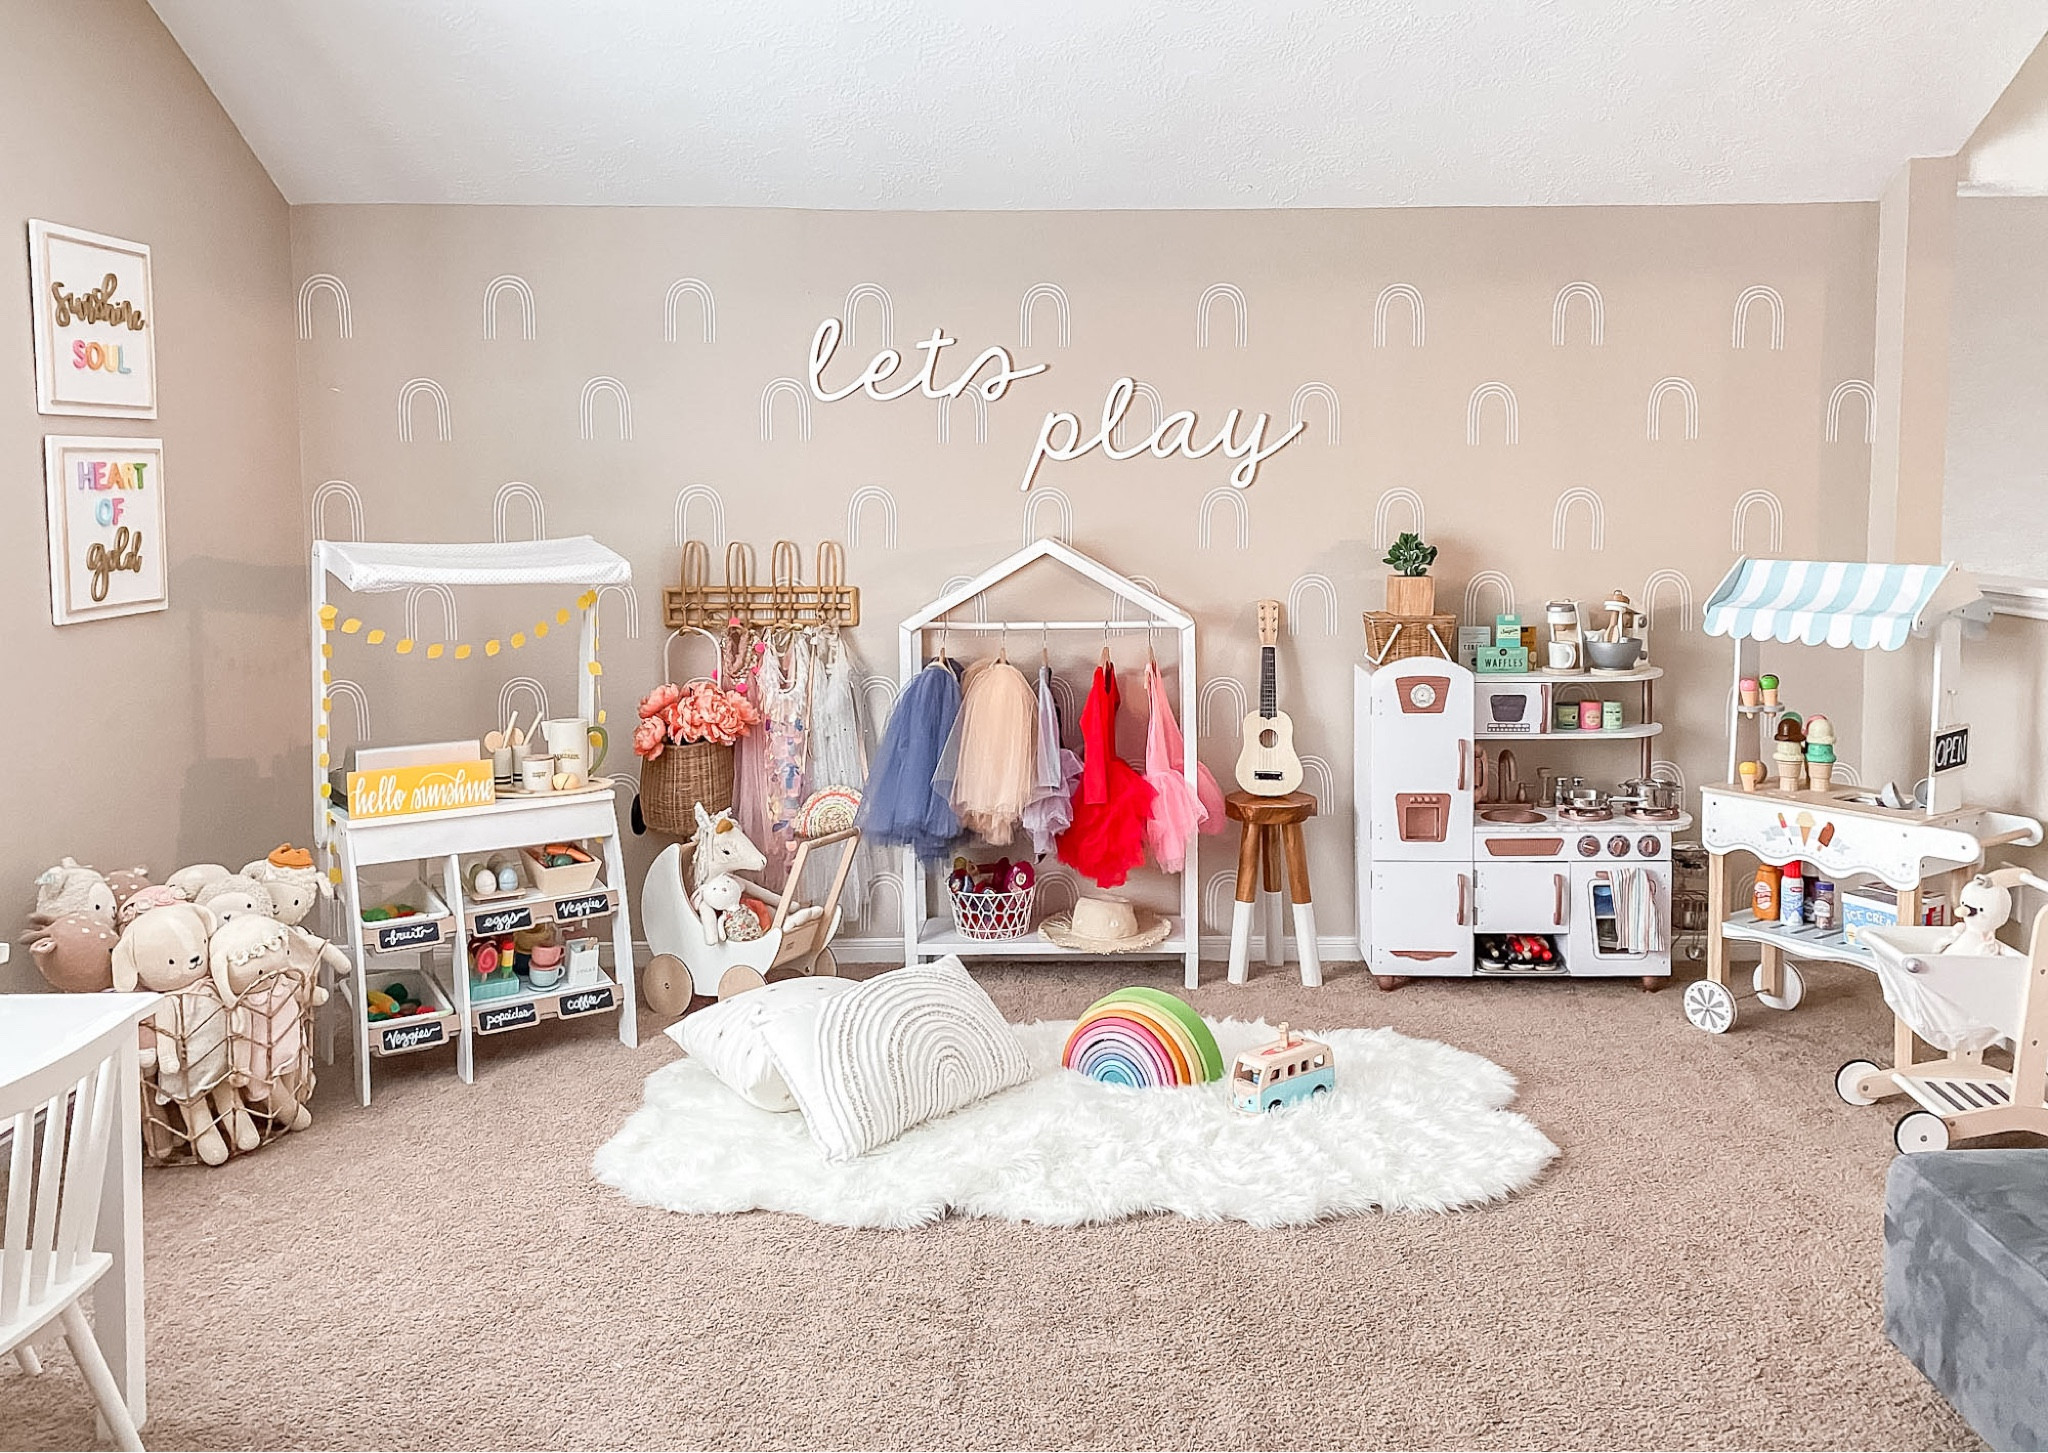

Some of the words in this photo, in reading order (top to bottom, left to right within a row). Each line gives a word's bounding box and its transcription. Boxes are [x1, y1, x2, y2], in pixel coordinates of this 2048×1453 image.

[72, 339, 132, 374] SOUL
[809, 318, 1047, 401] lets
[1020, 377, 1305, 492] play
[77, 461, 148, 490] HEART
[95, 498, 125, 527] OF
[86, 526, 142, 602] gold
[1484, 657, 1523, 668] WAFFLES
[1935, 734, 1967, 767] OPEN
[350, 777, 408, 816] hello
[410, 769, 494, 810] sunshine
[482, 909, 529, 931] eggs
[1845, 908, 1864, 922] ICE
[567, 991, 610, 1011] coffee
